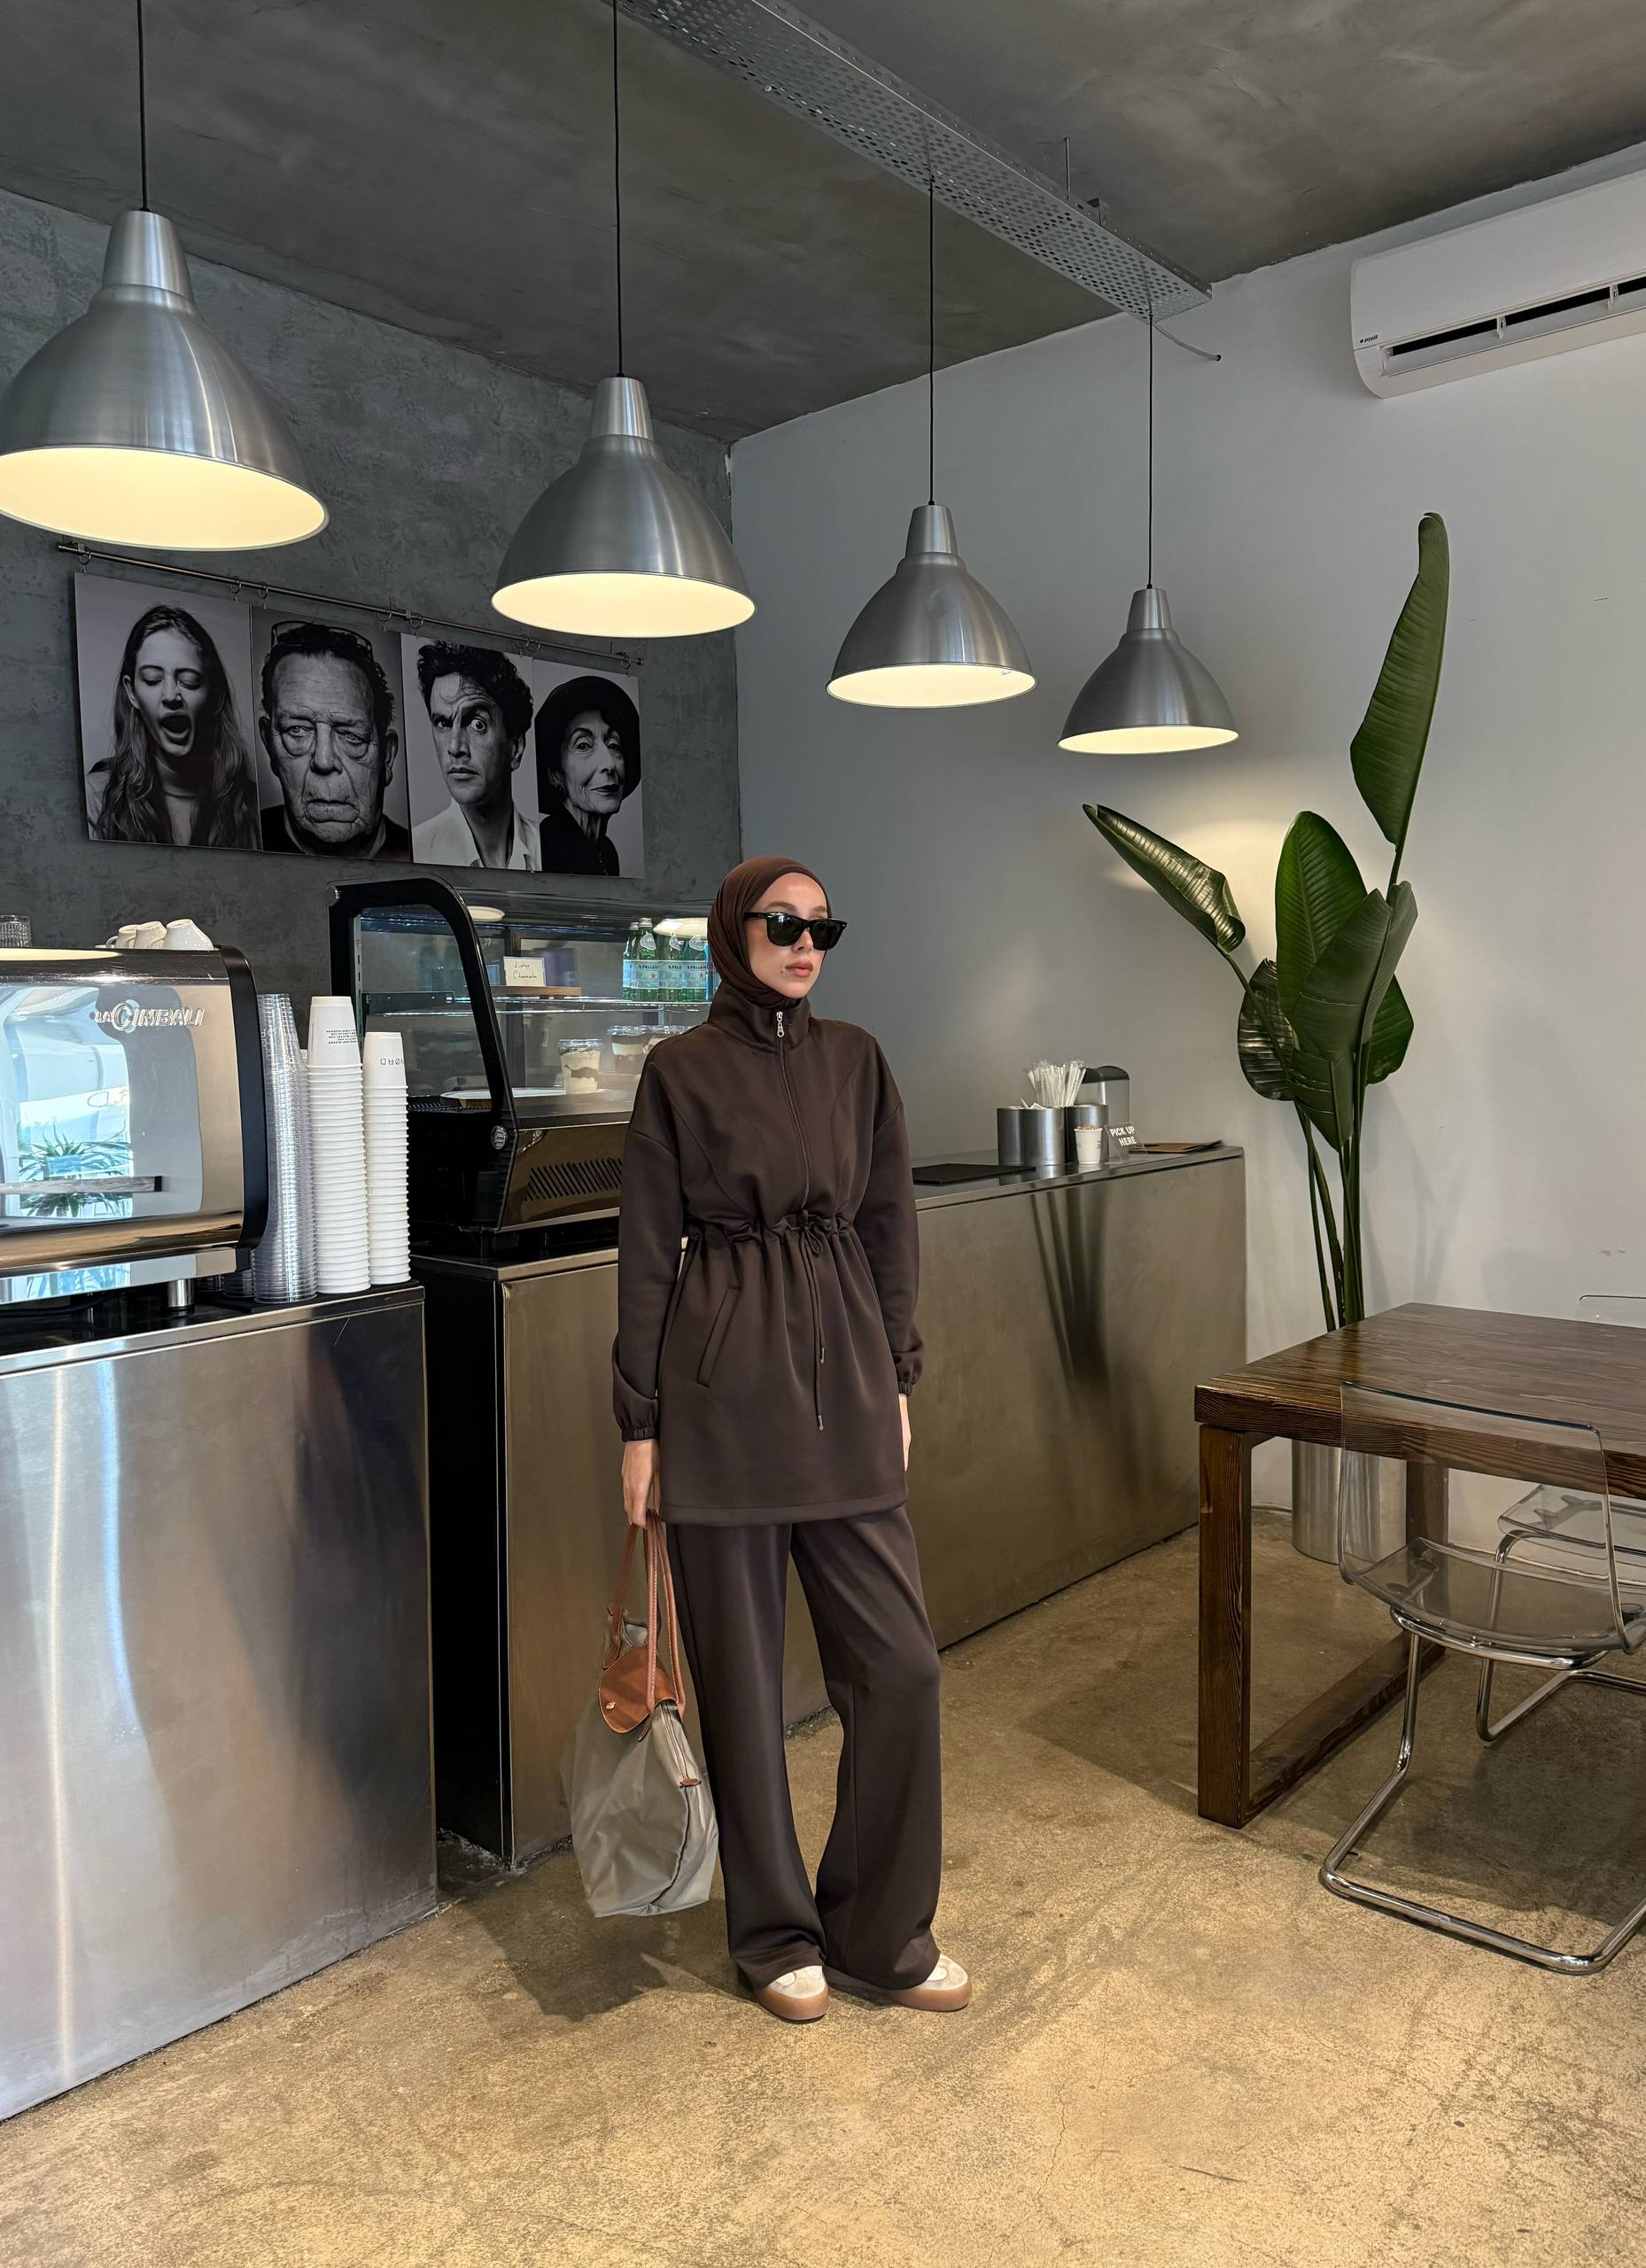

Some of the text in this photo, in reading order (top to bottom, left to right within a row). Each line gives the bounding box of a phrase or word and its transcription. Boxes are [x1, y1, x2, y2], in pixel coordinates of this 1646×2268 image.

[95, 1001, 205, 1031] LA CIMBALI
[1109, 1128, 1127, 1137] PICK
[1118, 1136, 1137, 1146] HERE
